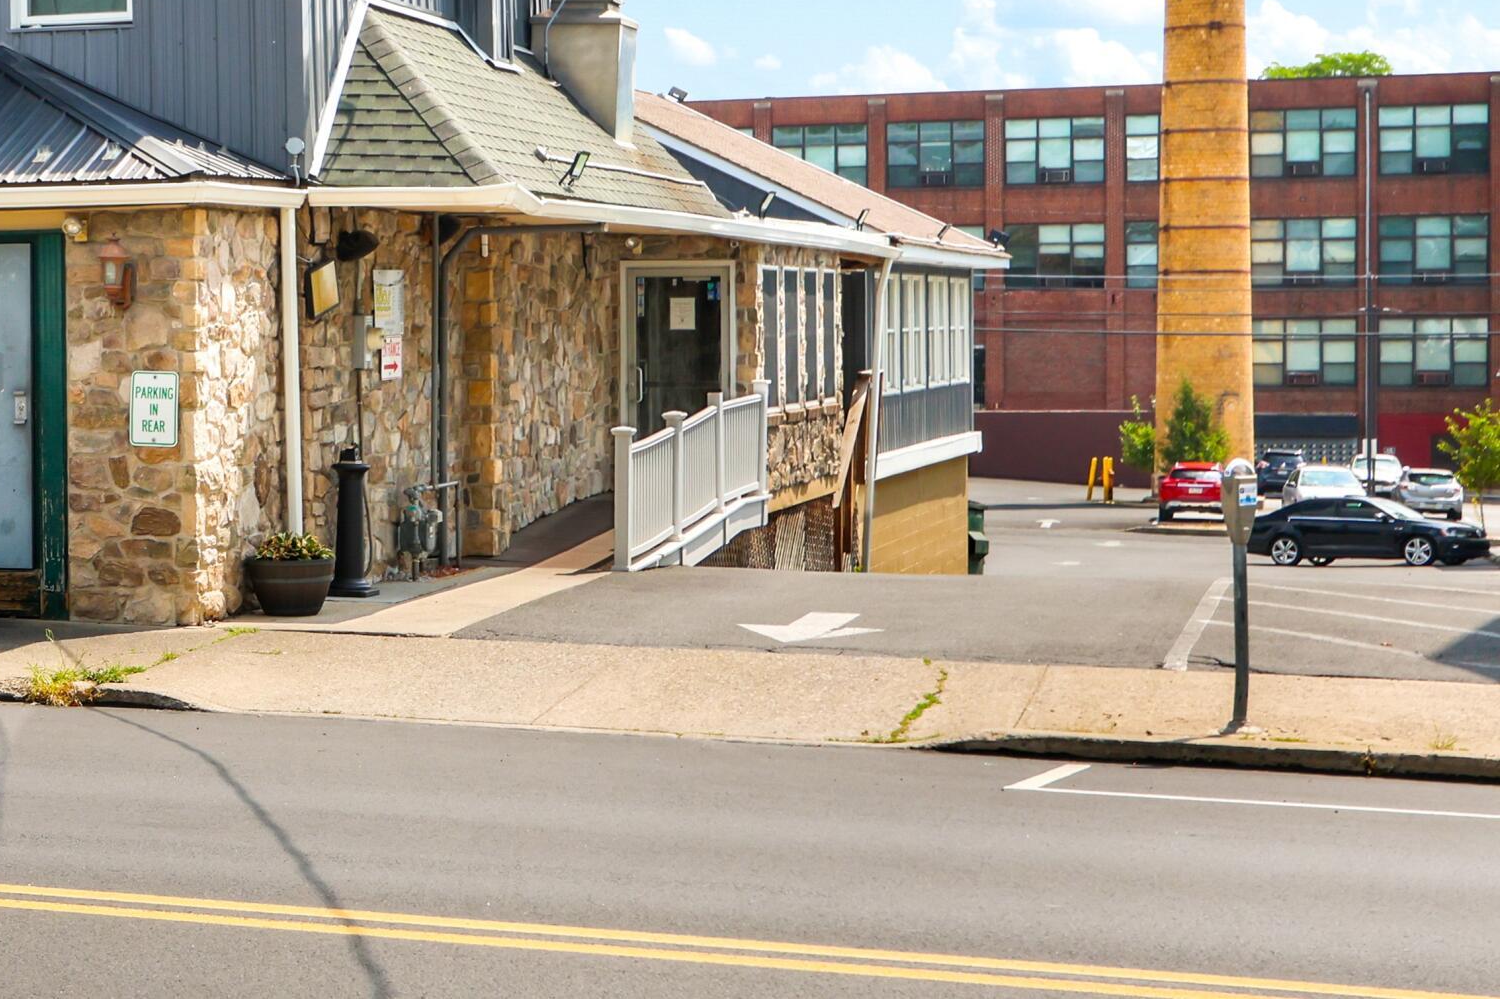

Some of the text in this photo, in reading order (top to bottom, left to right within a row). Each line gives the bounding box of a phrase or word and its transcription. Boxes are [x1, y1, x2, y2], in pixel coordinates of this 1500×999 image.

[135, 386, 173, 399] PARKING
[149, 404, 159, 415] IN
[142, 420, 165, 432] REAR
